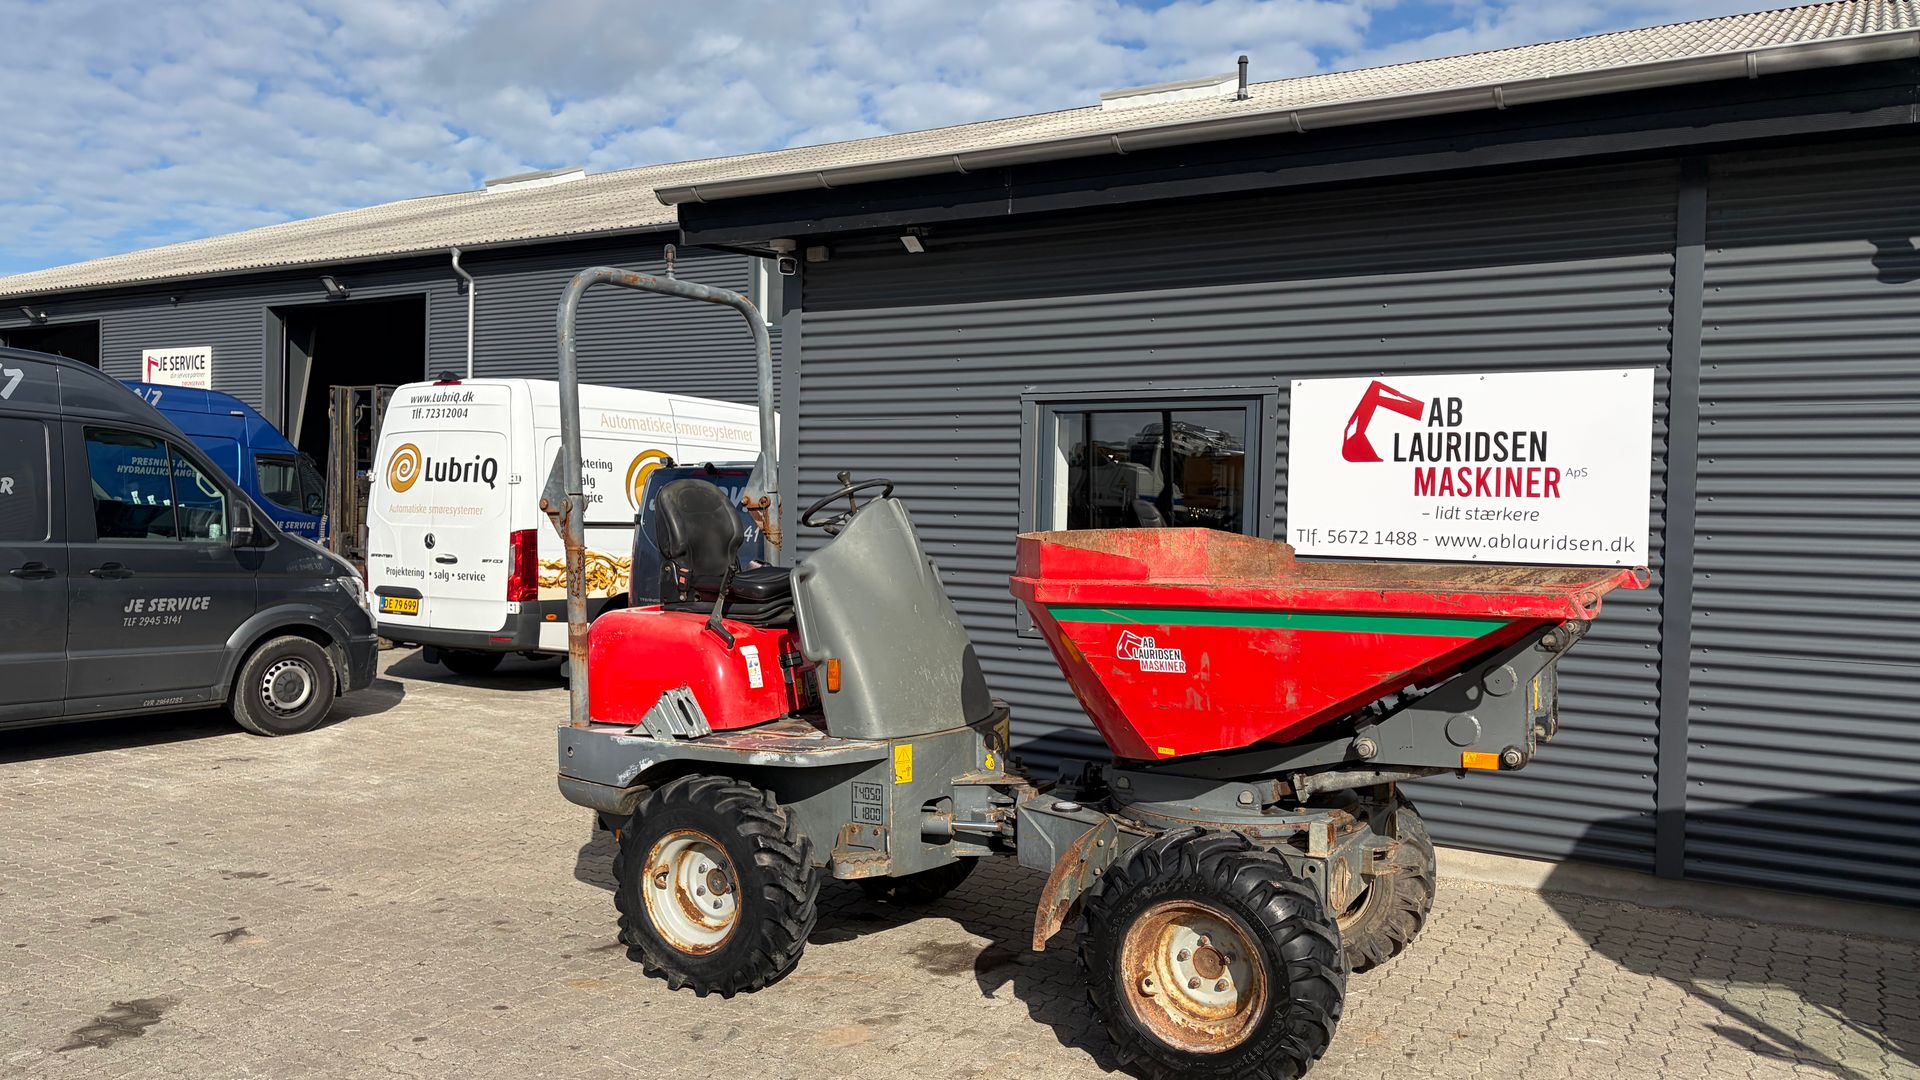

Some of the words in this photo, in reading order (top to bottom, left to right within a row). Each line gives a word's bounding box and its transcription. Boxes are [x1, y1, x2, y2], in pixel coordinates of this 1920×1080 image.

[158, 356, 168, 372] JE
[169, 354, 206, 372] SERVICE
[0, 363, 24, 400] 7
[410, 391, 475, 405] www.LubriQ.dk
[425, 407, 469, 420] 72312004
[1427, 396, 1463, 428] AB
[600, 412, 673, 435] Automatiske
[675, 421, 753, 443] smøresystemer
[1393, 430, 1548, 463] LAURIDSEN
[131, 456, 175, 467] PRESNIN
[581, 458, 613, 472] ktering
[424, 454, 499, 490] LubriQ
[581, 473, 596, 489] alg
[1413, 466, 1562, 499] MASKINER
[1565, 467, 1589, 479] ApS
[389, 503, 428, 514] Automatiske
[428, 505, 484, 517] smøresystemer
[1435, 506, 1460, 521] lidt
[1465, 507, 1541, 523] stærkere
[285, 521, 317, 530] SERVICE
[743, 525, 761, 543] 41
[1296, 528, 1322, 545] Tlf.
[1327, 529, 1370, 545] 5672
[1374, 530, 1418, 547] 1488
[1434, 533, 1637, 554] www.ablauridsen.dk
[386, 566, 425, 580] Projektering
[434, 569, 450, 583] salg
[457, 570, 486, 582] service
[124, 598, 146, 613] JE
[148, 596, 212, 613] SERVICE
[394, 599, 403, 610] 79
[403, 600, 417, 611] 699
[123, 617, 138, 627] TLF
[138, 615, 161, 627] 2945
[162, 614, 182, 625] 3141
[1142, 637, 1154, 648] AB
[1133, 648, 1181, 660] LAURIDSEN
[1141, 660, 1185, 672] MASKINER
